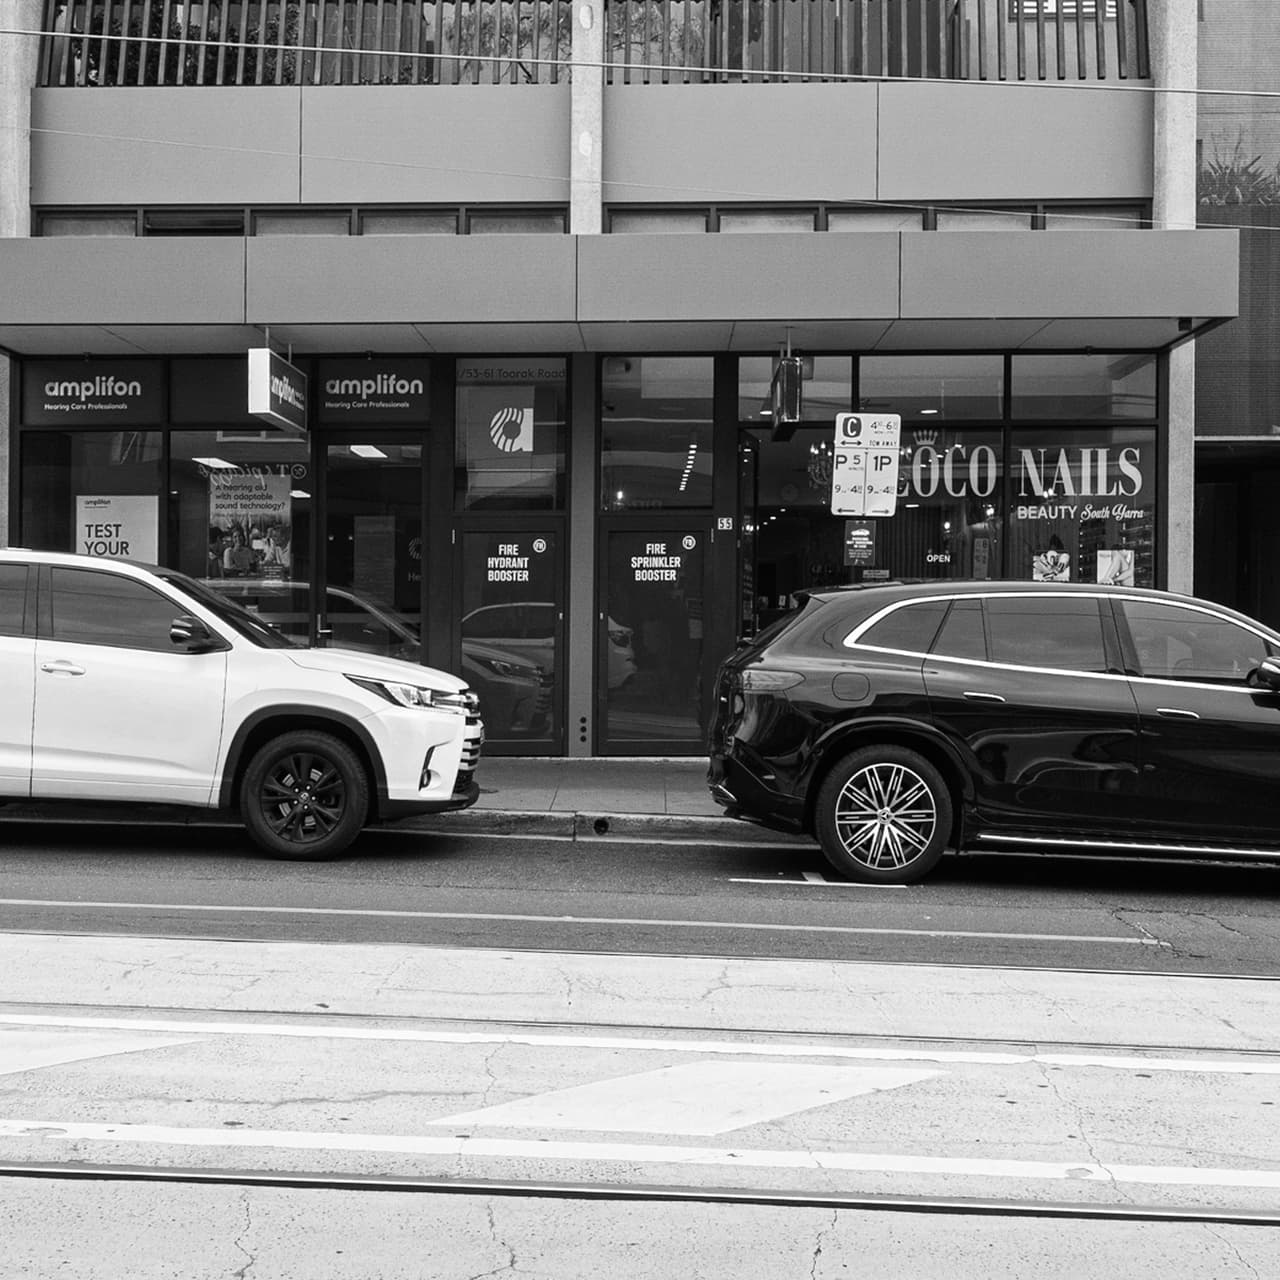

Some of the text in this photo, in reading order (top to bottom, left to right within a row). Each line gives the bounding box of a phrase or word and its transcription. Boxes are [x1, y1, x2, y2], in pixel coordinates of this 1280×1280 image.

[496, 368, 535, 379] Toorak
[537, 368, 566, 379] Road
[45, 375, 141, 401] amplifon
[325, 373, 423, 399] amplifon
[44, 403, 70, 411] Hearing
[873, 456, 892, 471] 1P
[1018, 448, 1143, 497] NAILS
[1017, 503, 1144, 521] BEAUTY South Yarra
[85, 524, 122, 538] TEST
[84, 541, 130, 556] YOUR
[499, 544, 519, 556] FIRE
[646, 543, 667, 555] FIRE
[487, 557, 529, 568] HYDRANT
[631, 556, 681, 568] SPRINKLER
[926, 554, 951, 563] OPEN
[488, 570, 529, 581] BOOSTER
[635, 569, 677, 581] BOOSTER
